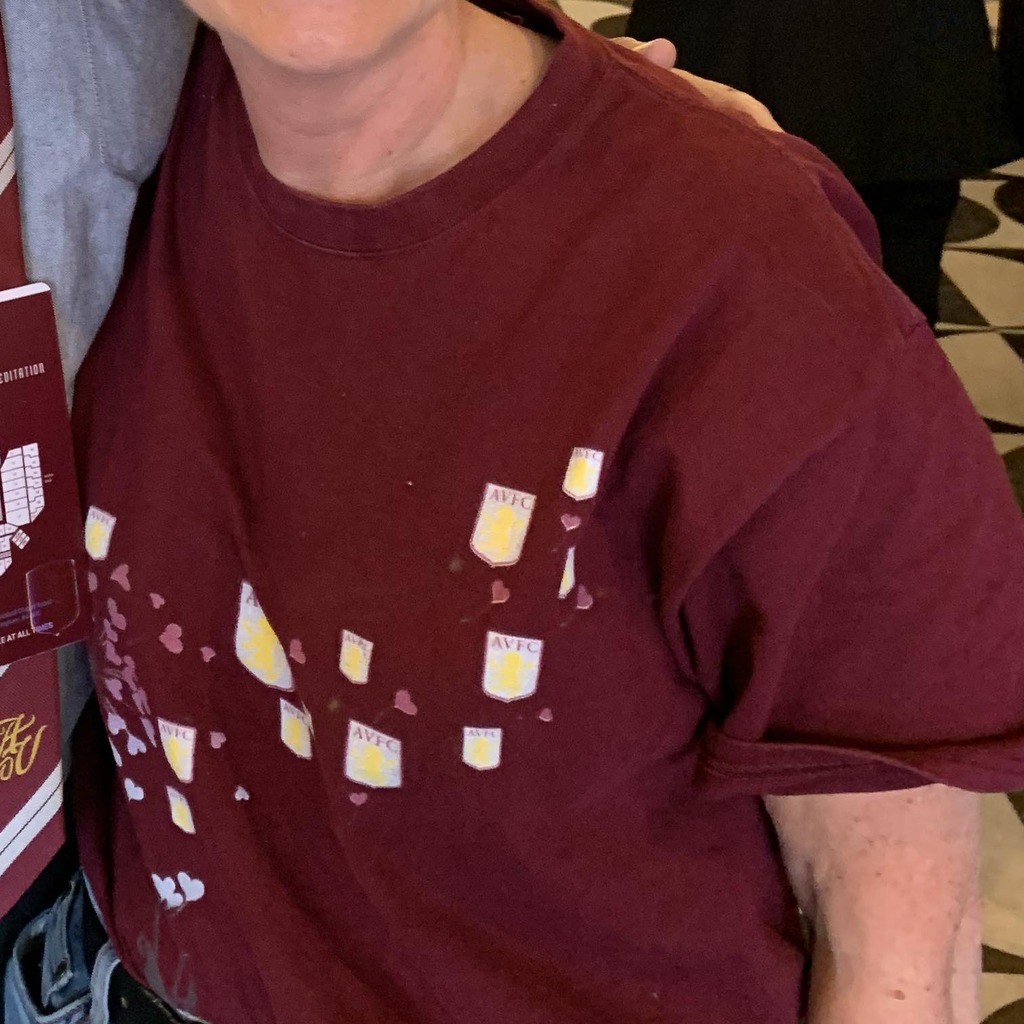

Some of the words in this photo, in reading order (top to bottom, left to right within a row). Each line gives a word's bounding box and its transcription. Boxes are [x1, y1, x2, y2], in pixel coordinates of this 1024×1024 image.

[489, 488, 533, 510] AVFC
[6, 633, 17, 643] AT
[17, 629, 31, 639] ALL
[491, 636, 540, 654] AVFC
[353, 726, 399, 754] AVFC
